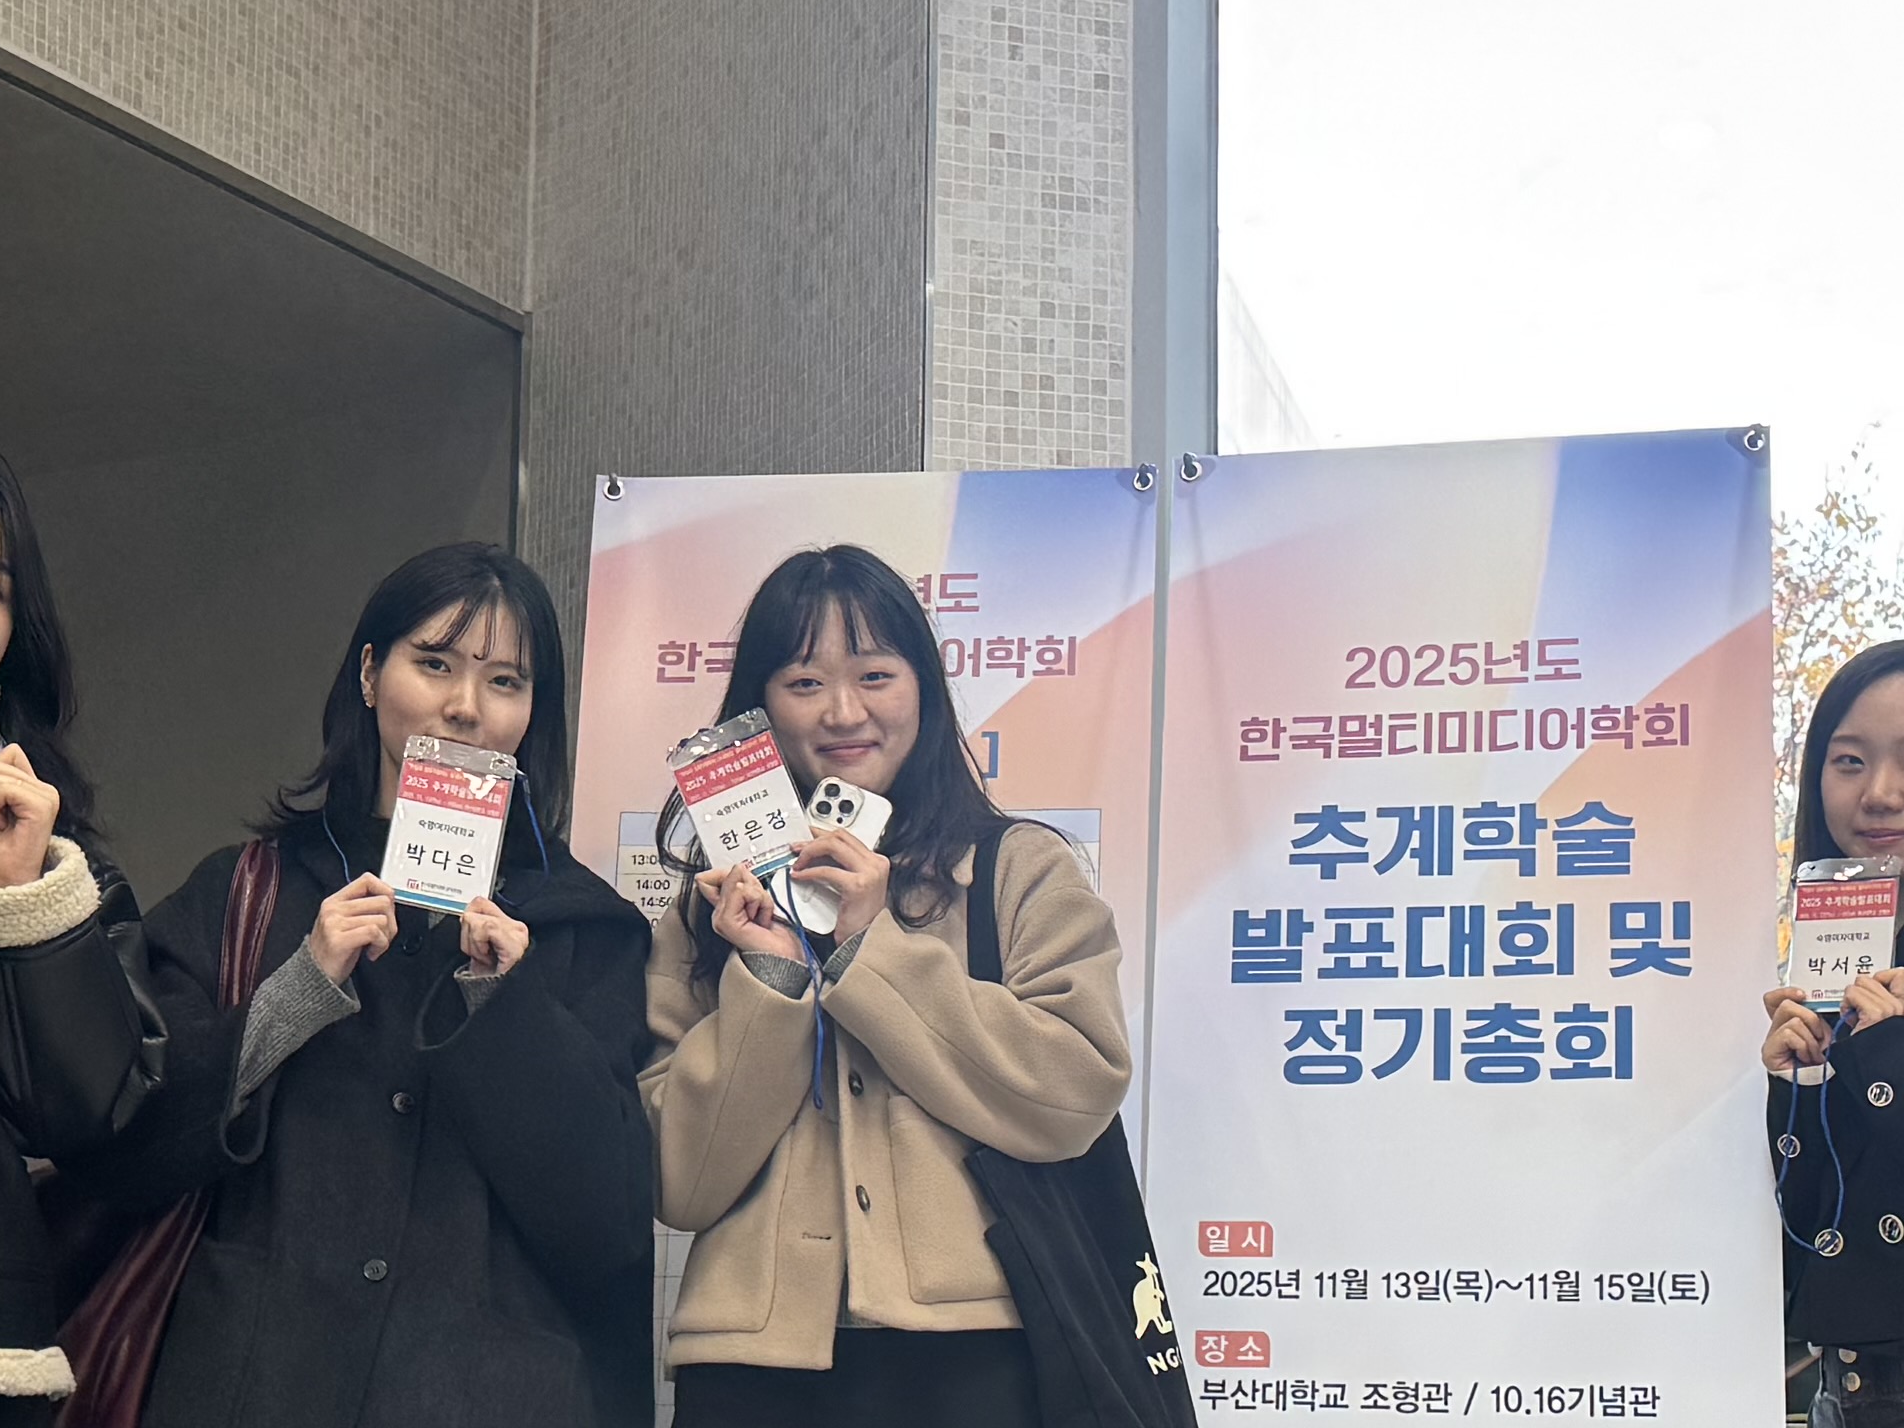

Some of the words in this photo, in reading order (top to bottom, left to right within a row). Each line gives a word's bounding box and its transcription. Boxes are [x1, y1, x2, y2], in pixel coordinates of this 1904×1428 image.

[1344, 637, 1583, 690] 2025년도
[1239, 702, 1691, 762] 한국멀티미디어학회
[1288, 801, 1636, 880] 추계학술
[636, 880, 670, 890] 14:00
[1231, 900, 1575, 984] 발표대회
[1609, 900, 1693, 978] 및
[1283, 1002, 1634, 1085] 정기총회
[1202, 1269, 1300, 1300] 2025년
[1313, 1268, 1369, 1300] 11월
[1594, 1270, 1711, 1305] 15일(토)
[1199, 1379, 1350, 1413] 부산대학교
[1360, 1383, 1453, 1415] 조형관
[1463, 1383, 1479, 1416] /
[1490, 1384, 1661, 1419] 10.16기념관
